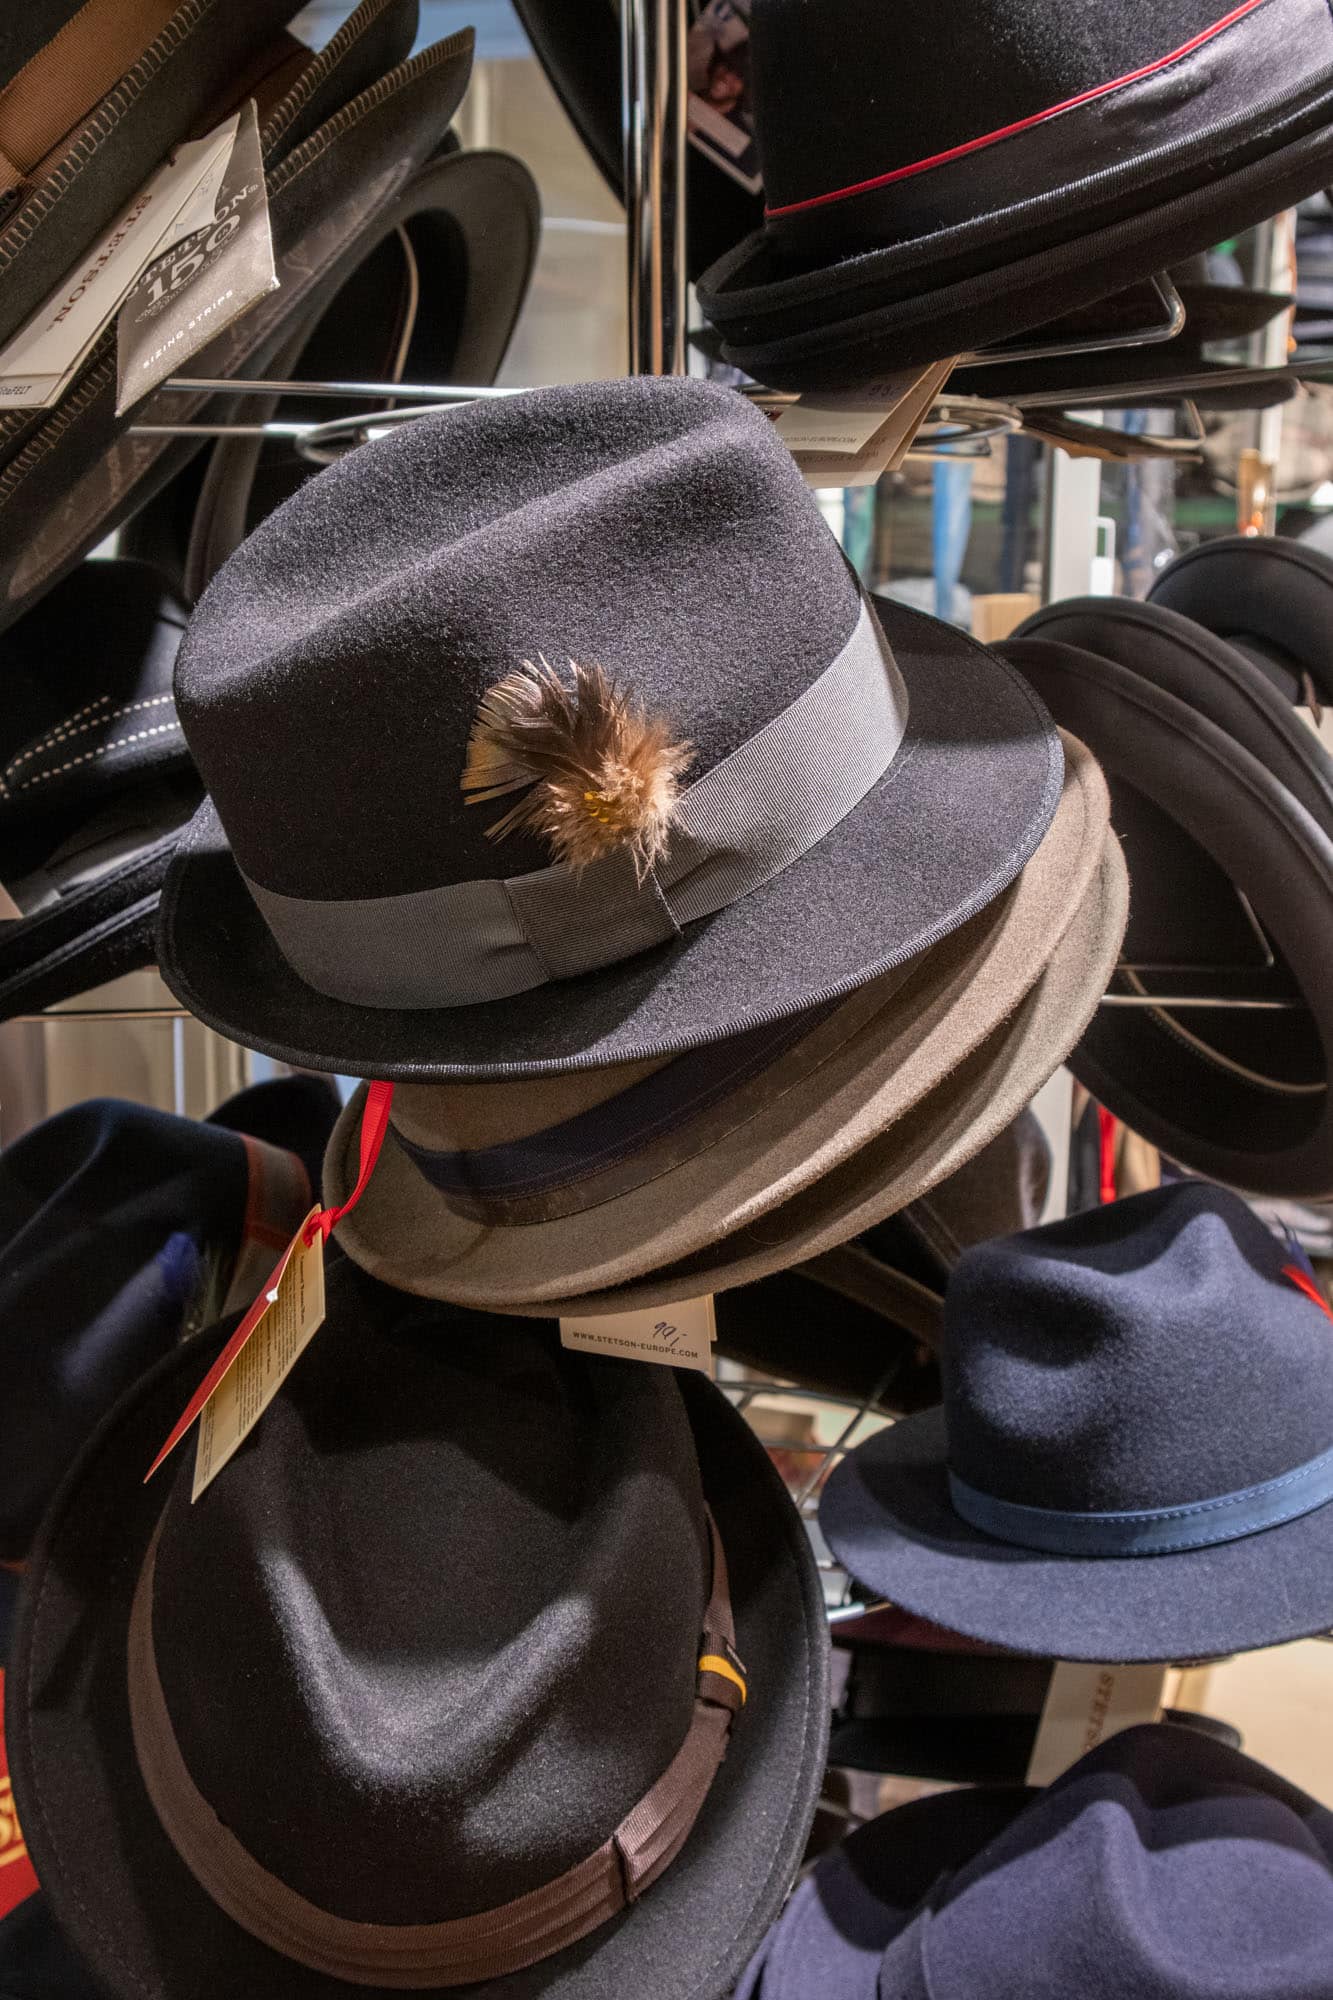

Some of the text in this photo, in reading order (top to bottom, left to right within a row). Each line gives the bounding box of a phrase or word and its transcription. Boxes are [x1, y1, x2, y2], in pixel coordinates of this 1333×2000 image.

[147, 214, 240, 308] 150
[142, 289, 233, 369] SIZING STRIPS
[573, 1331, 698, 1358] WWW.STETSON-EUROPE.COM
